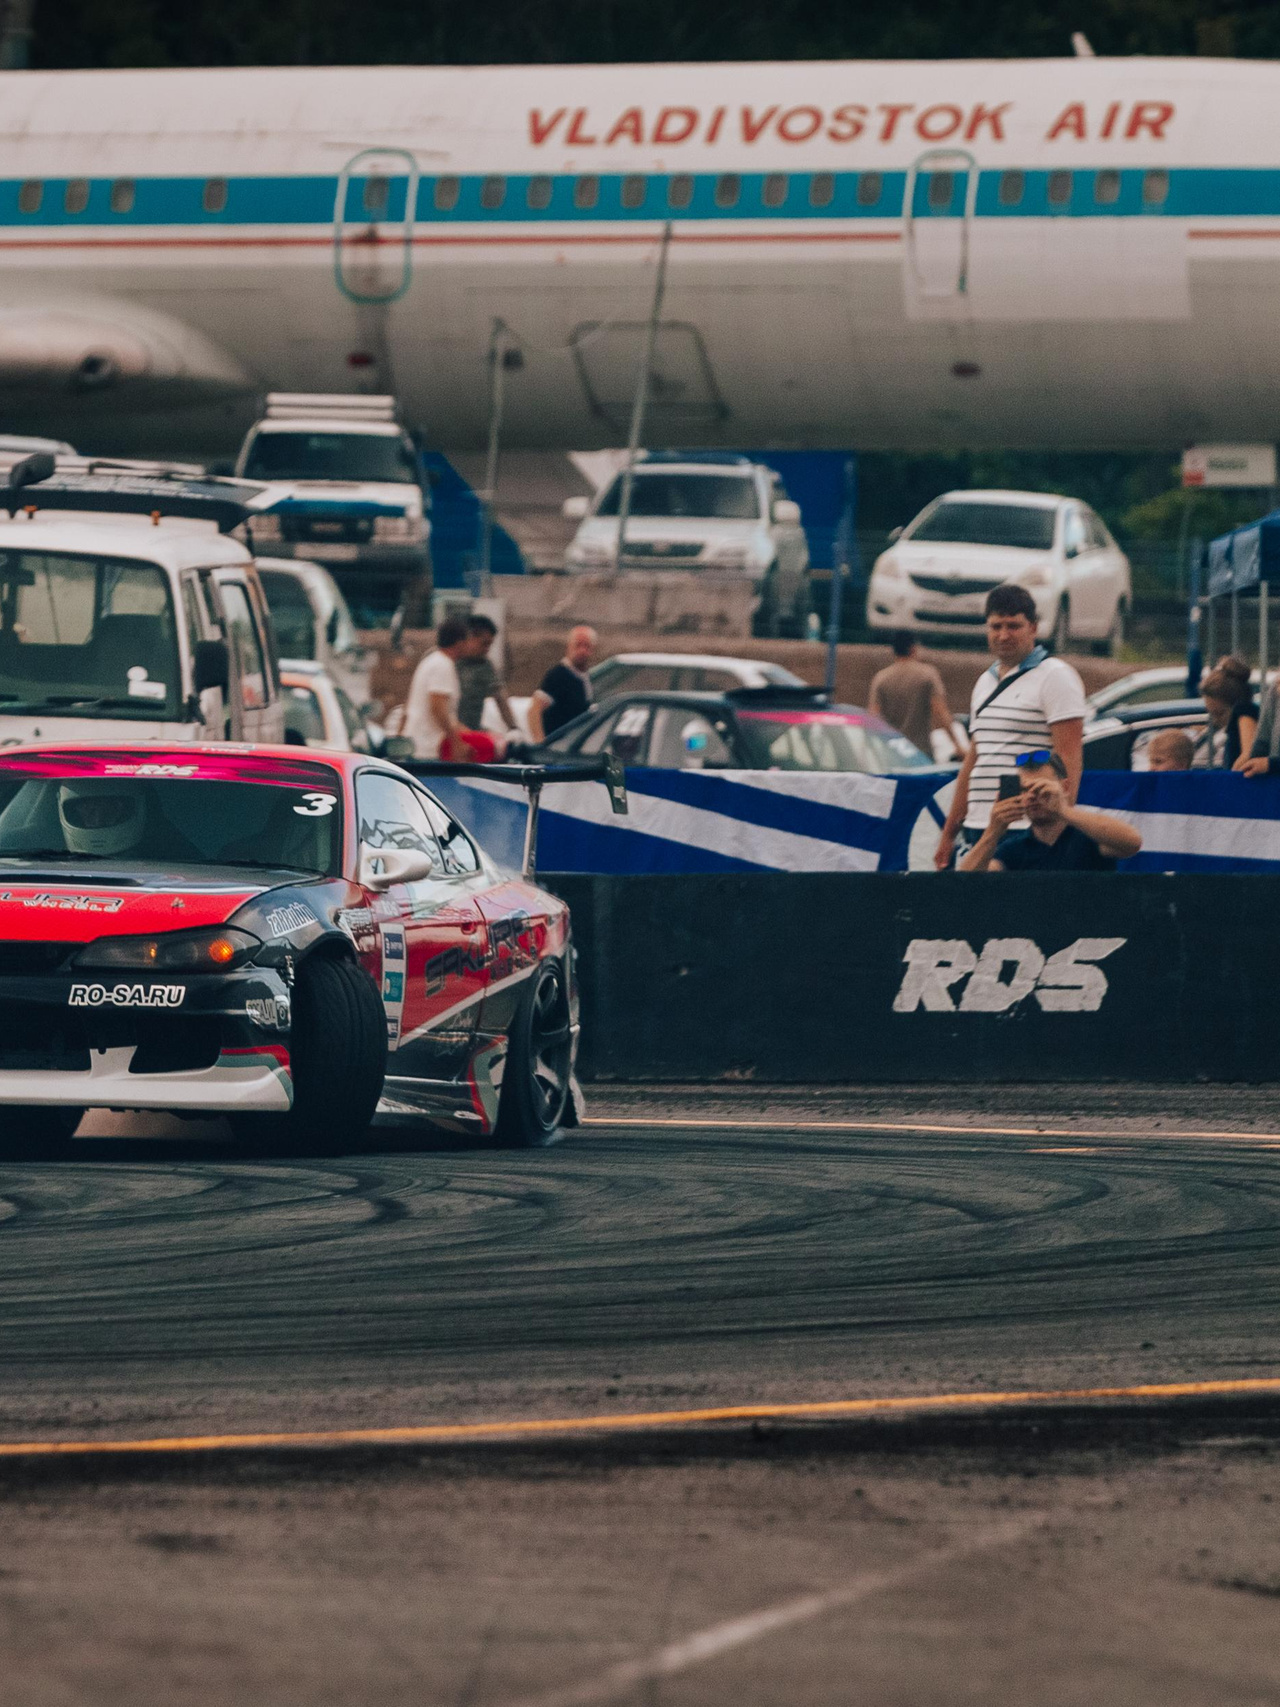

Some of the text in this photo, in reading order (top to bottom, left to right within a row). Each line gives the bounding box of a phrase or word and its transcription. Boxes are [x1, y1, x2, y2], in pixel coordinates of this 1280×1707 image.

[528, 100, 1176, 148] VLADIVOSTOK AIR
[135, 763, 200, 777] RDS
[293, 793, 338, 816] 3
[892, 937, 1128, 1012] RDS
[68, 983, 186, 1007] RO-SA.RU
